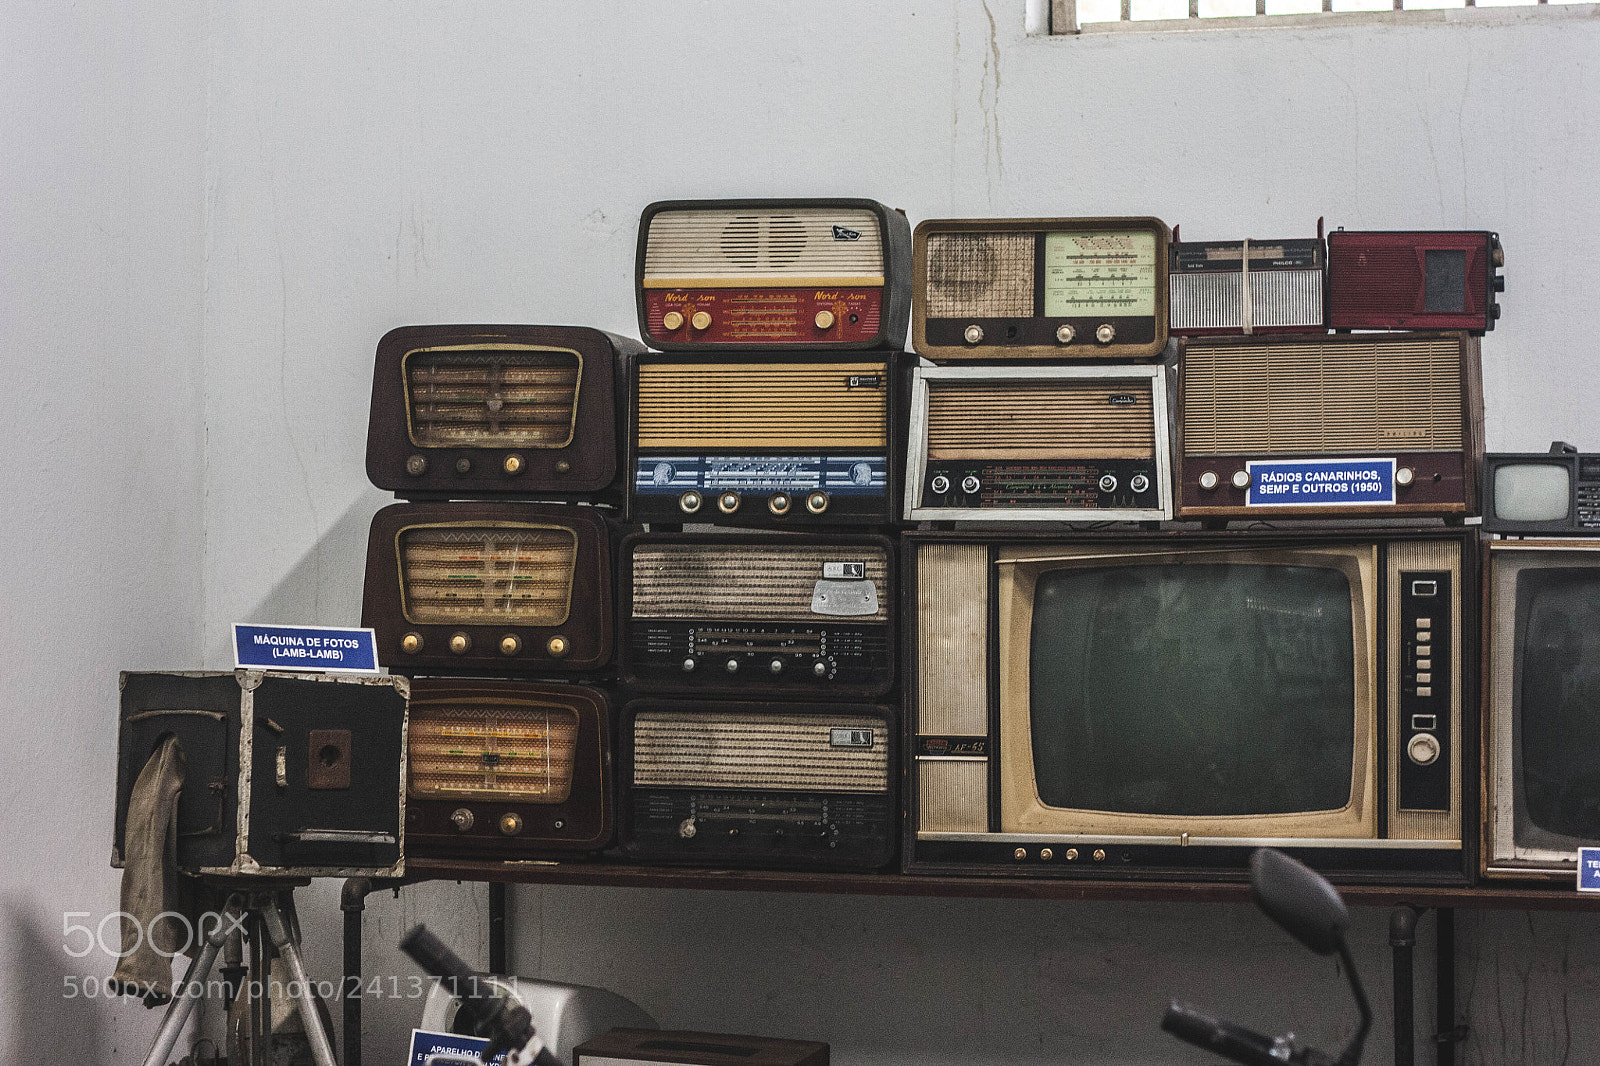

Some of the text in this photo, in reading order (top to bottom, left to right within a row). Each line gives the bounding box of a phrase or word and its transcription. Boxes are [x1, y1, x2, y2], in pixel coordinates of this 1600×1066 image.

[664, 292, 689, 302] Nord
[696, 294, 716, 302] son
[813, 291, 839, 301] Nord
[846, 292, 866, 301] son
[1261, 470, 1381, 483] RÁDIOS CANARINHOS,
[1260, 481, 1382, 494] SEMP E OUTROS (1950)
[253, 634, 359, 648] MÁQUINA DE FOTOS
[272, 647, 343, 661] (LAMB-LAMB)
[417, 1052, 423, 1061] E
[430, 1045, 473, 1057] APARELHO
